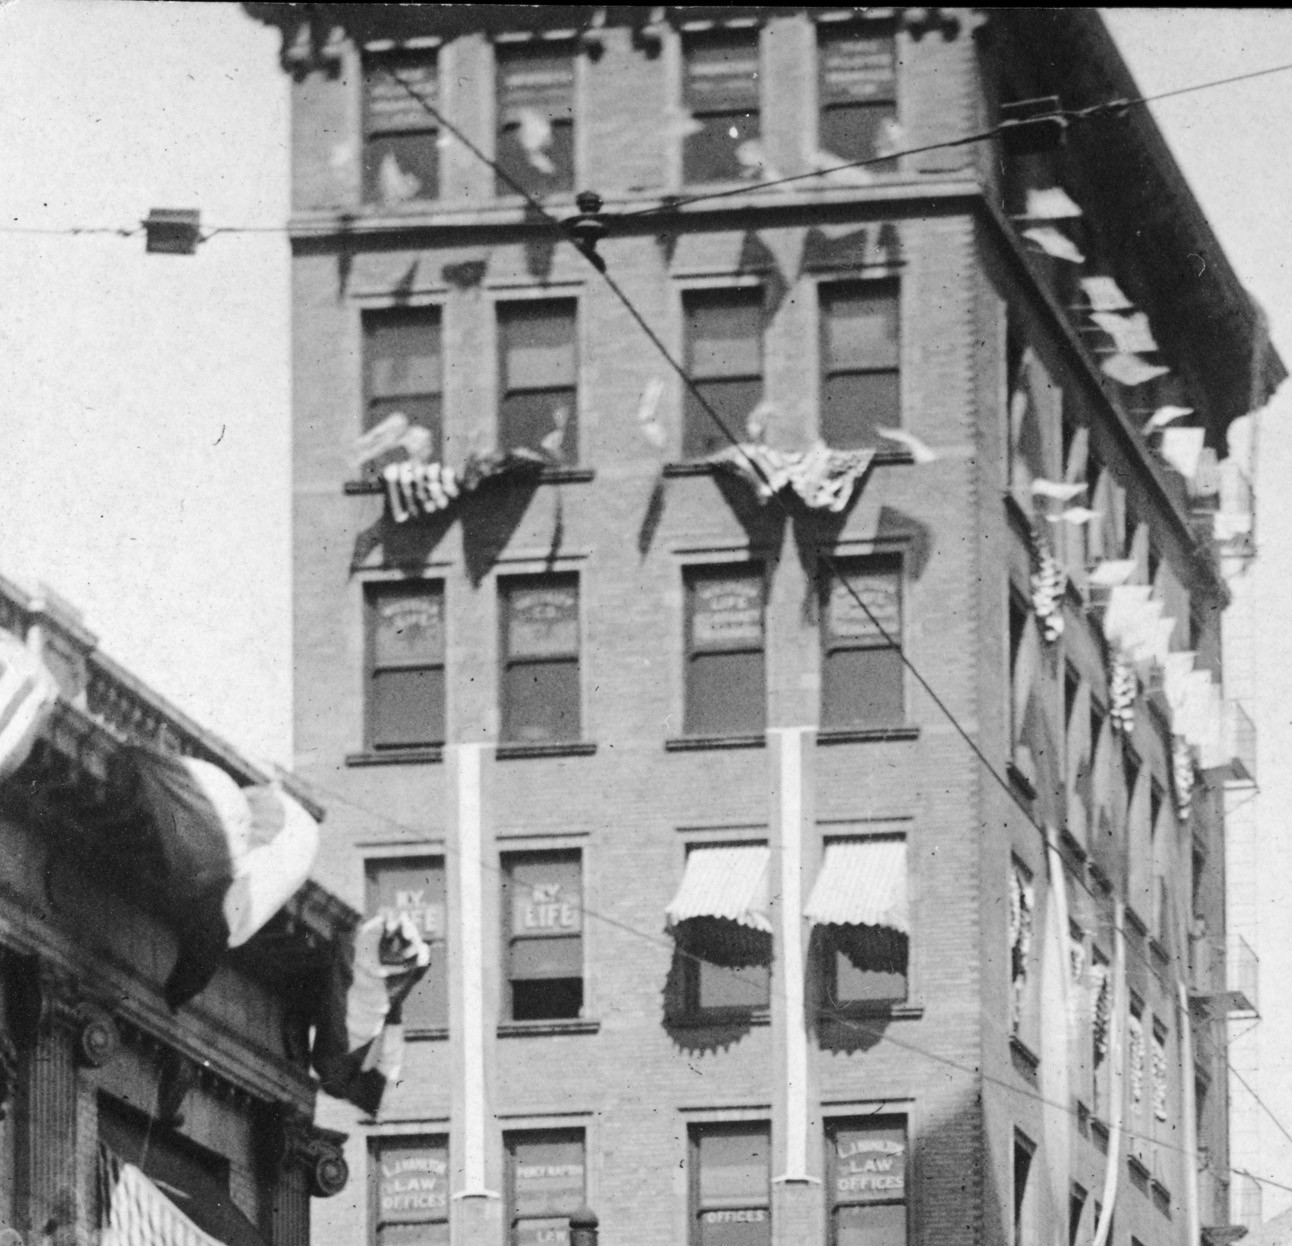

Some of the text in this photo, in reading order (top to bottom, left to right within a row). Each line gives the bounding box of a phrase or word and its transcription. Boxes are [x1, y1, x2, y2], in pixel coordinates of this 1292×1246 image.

[526, 904, 574, 928] LIFE
[850, 1159, 893, 1174] LAW
[394, 1178, 437, 1193] LAW
[837, 1175, 905, 1191] OFFICES
